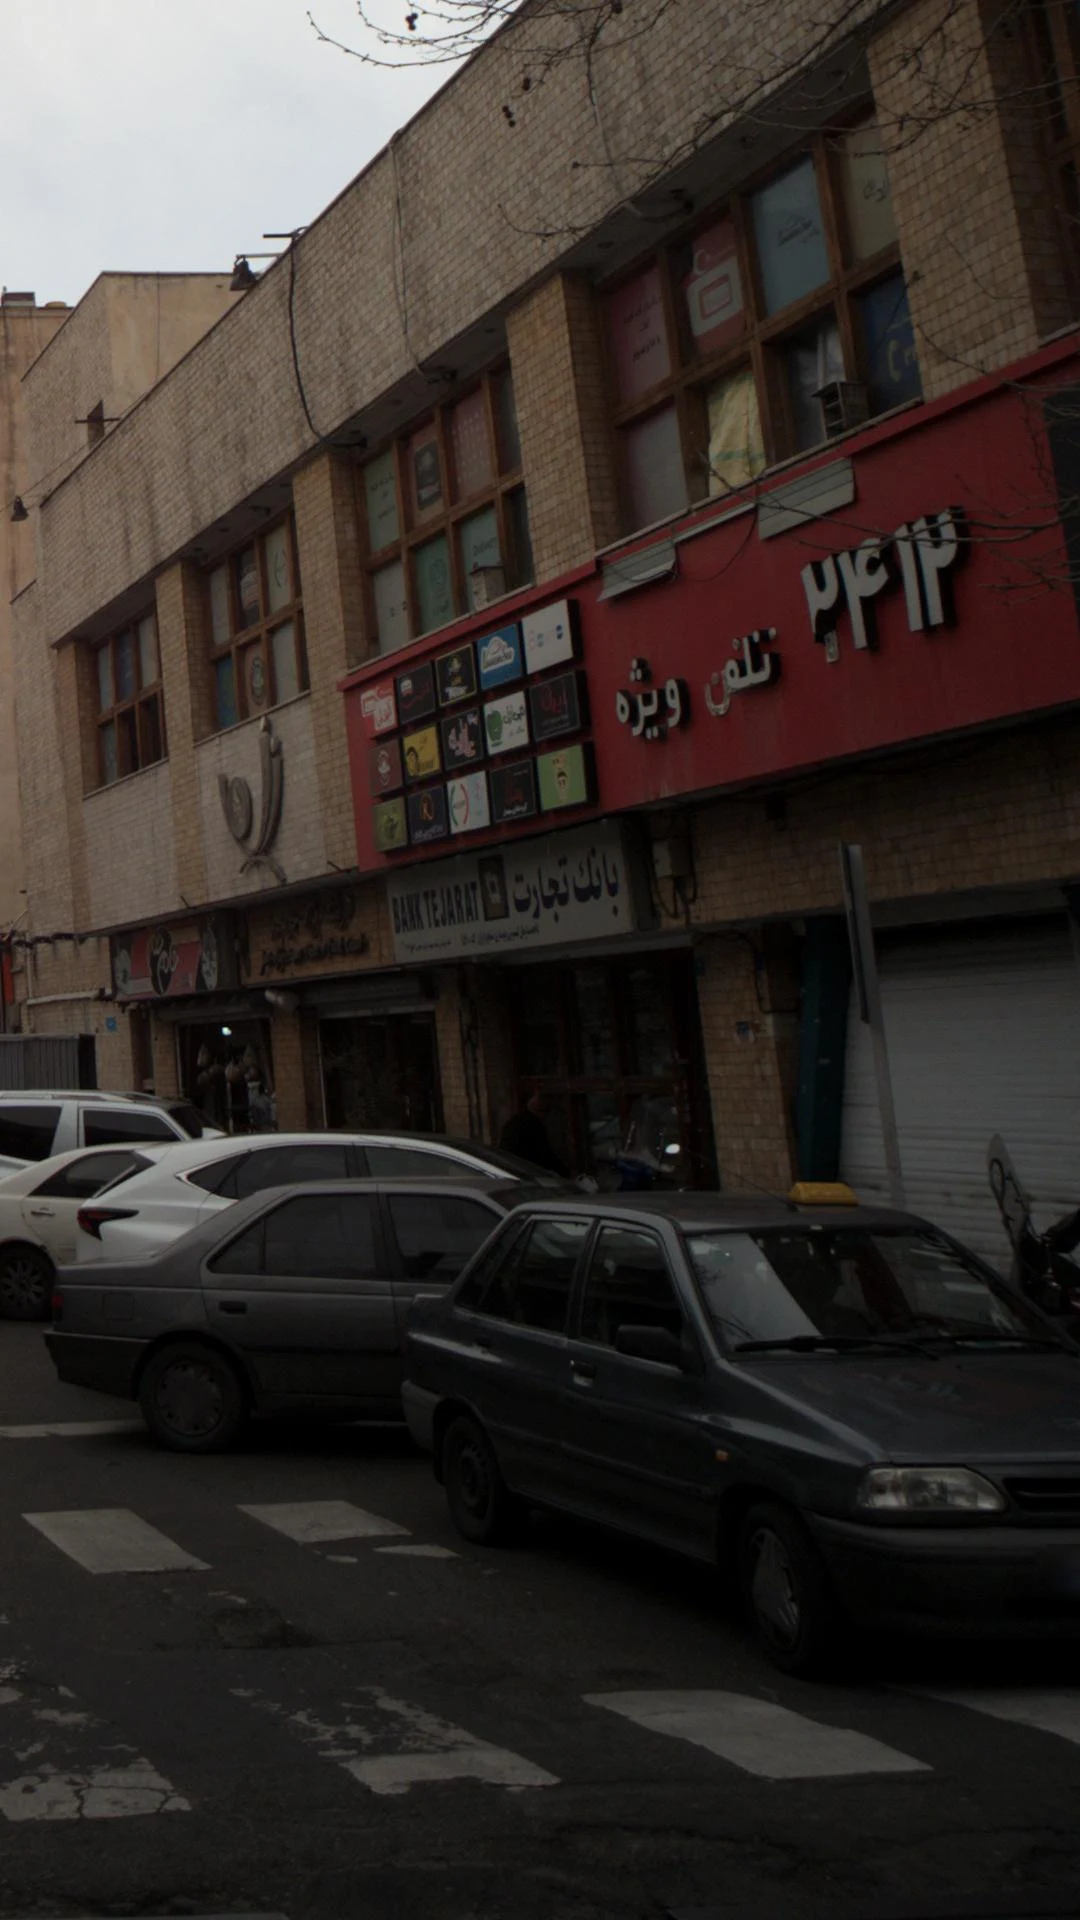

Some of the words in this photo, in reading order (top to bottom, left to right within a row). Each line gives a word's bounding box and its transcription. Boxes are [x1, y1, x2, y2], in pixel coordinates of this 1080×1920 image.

[615, 657, 683, 740] ویژه
[703, 627, 777, 716] تلفن
[391, 892, 425, 934] BANK
[425, 882, 480, 929] TEJARAT
[512, 855, 570, 923] تجارت
